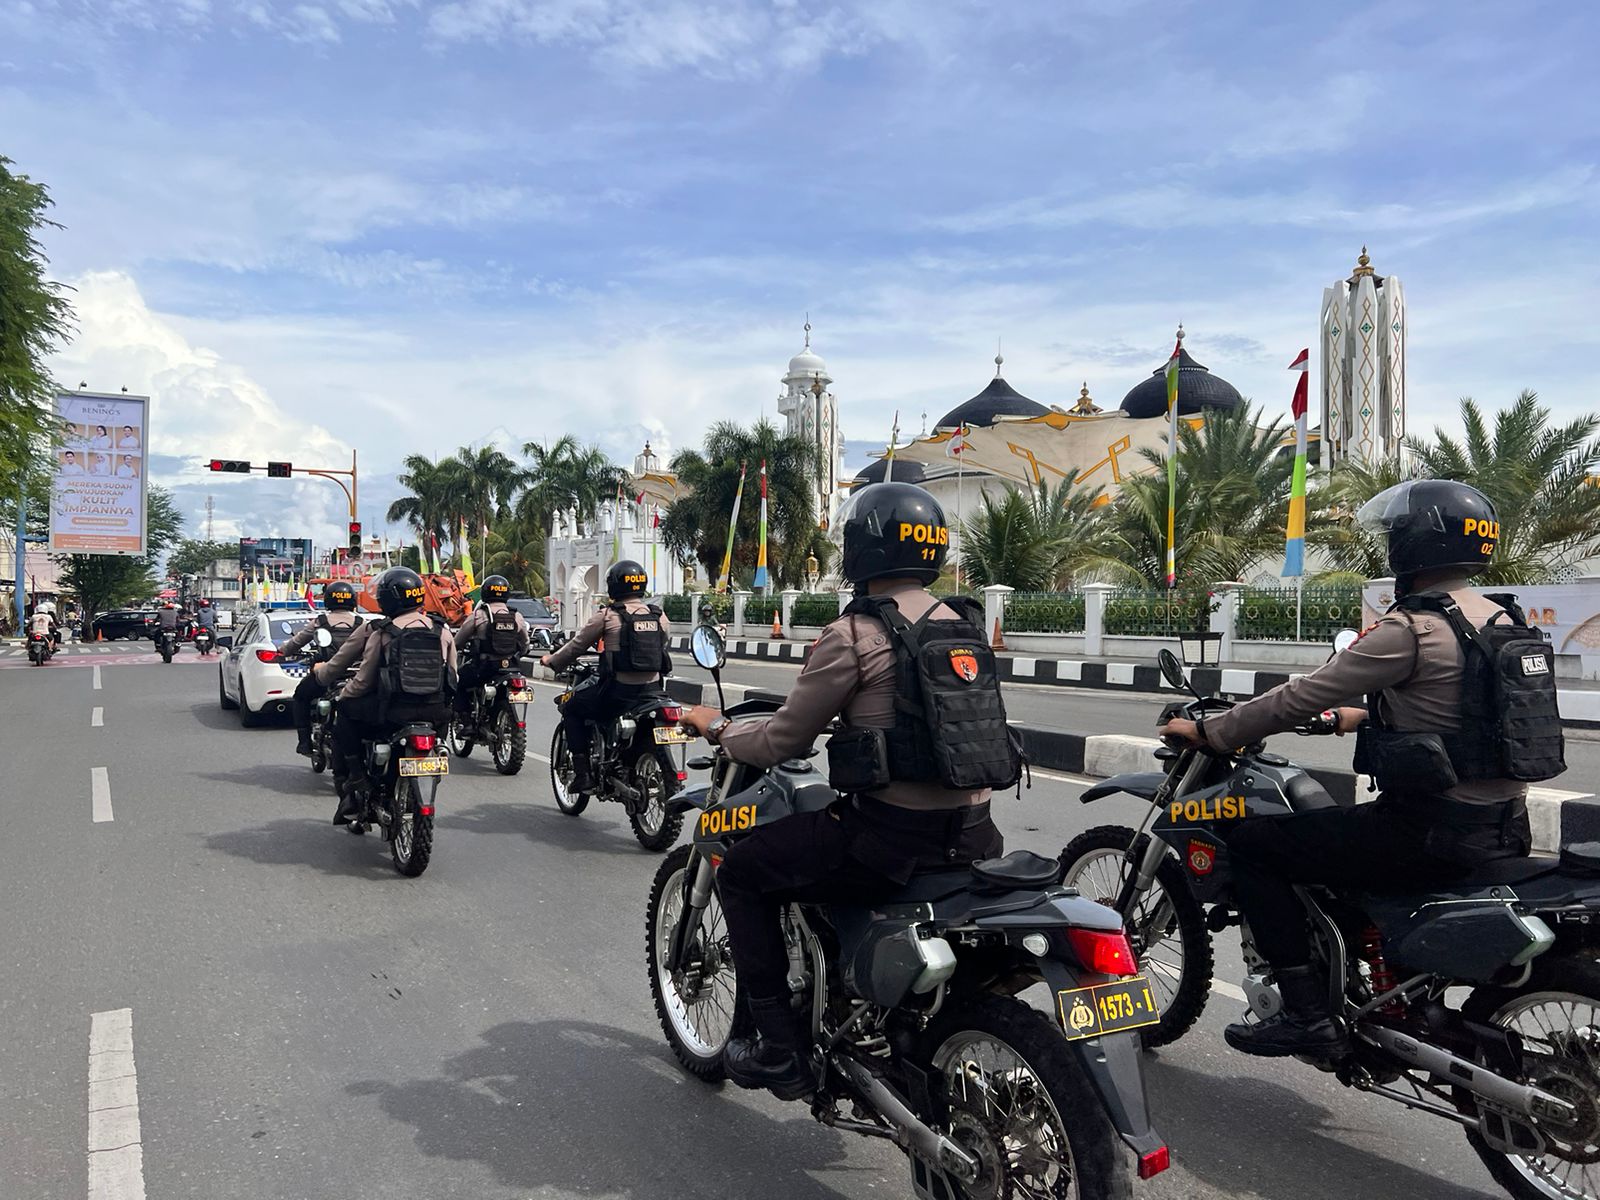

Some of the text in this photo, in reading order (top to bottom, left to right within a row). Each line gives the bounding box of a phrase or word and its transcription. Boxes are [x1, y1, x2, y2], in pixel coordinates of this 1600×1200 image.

[82, 496, 118, 505] KULIT
[65, 505, 134, 515] IMPIANNYA
[921, 548, 936, 560] 11
[1481, 543, 1493, 555] 02
[1525, 607, 1559, 625] AR
[1523, 656, 1547, 672] POLISI
[1170, 796, 1246, 824] POLISI
[701, 805, 757, 836] POLISI
